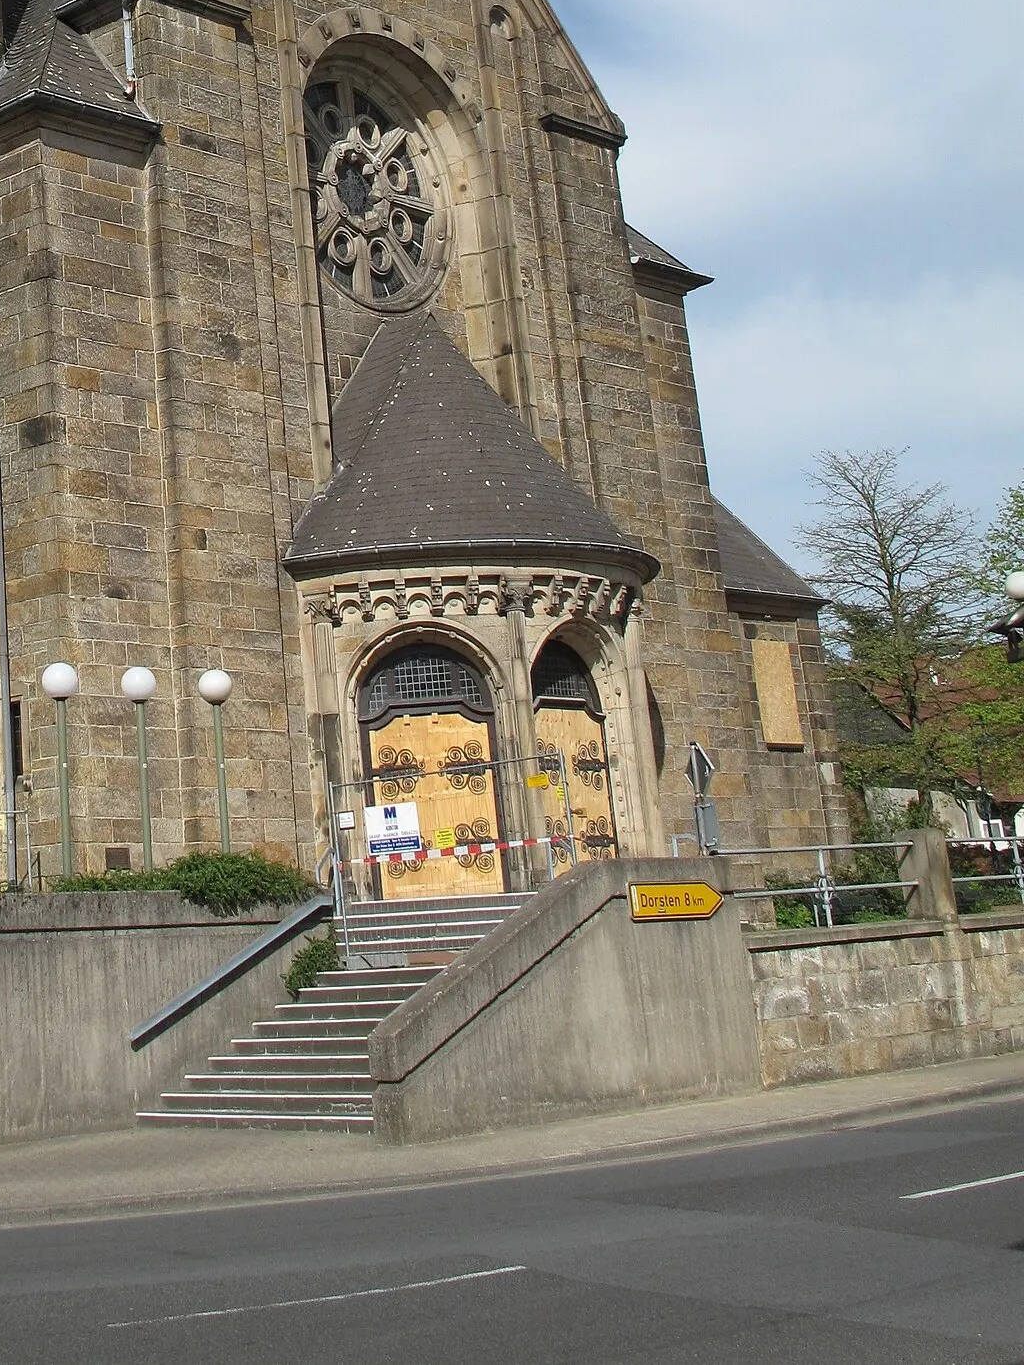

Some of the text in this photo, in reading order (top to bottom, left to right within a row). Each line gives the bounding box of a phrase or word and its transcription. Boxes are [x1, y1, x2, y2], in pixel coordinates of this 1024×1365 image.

[383, 806, 397, 819] M
[640, 892, 705, 908] Dorsten 8 km
